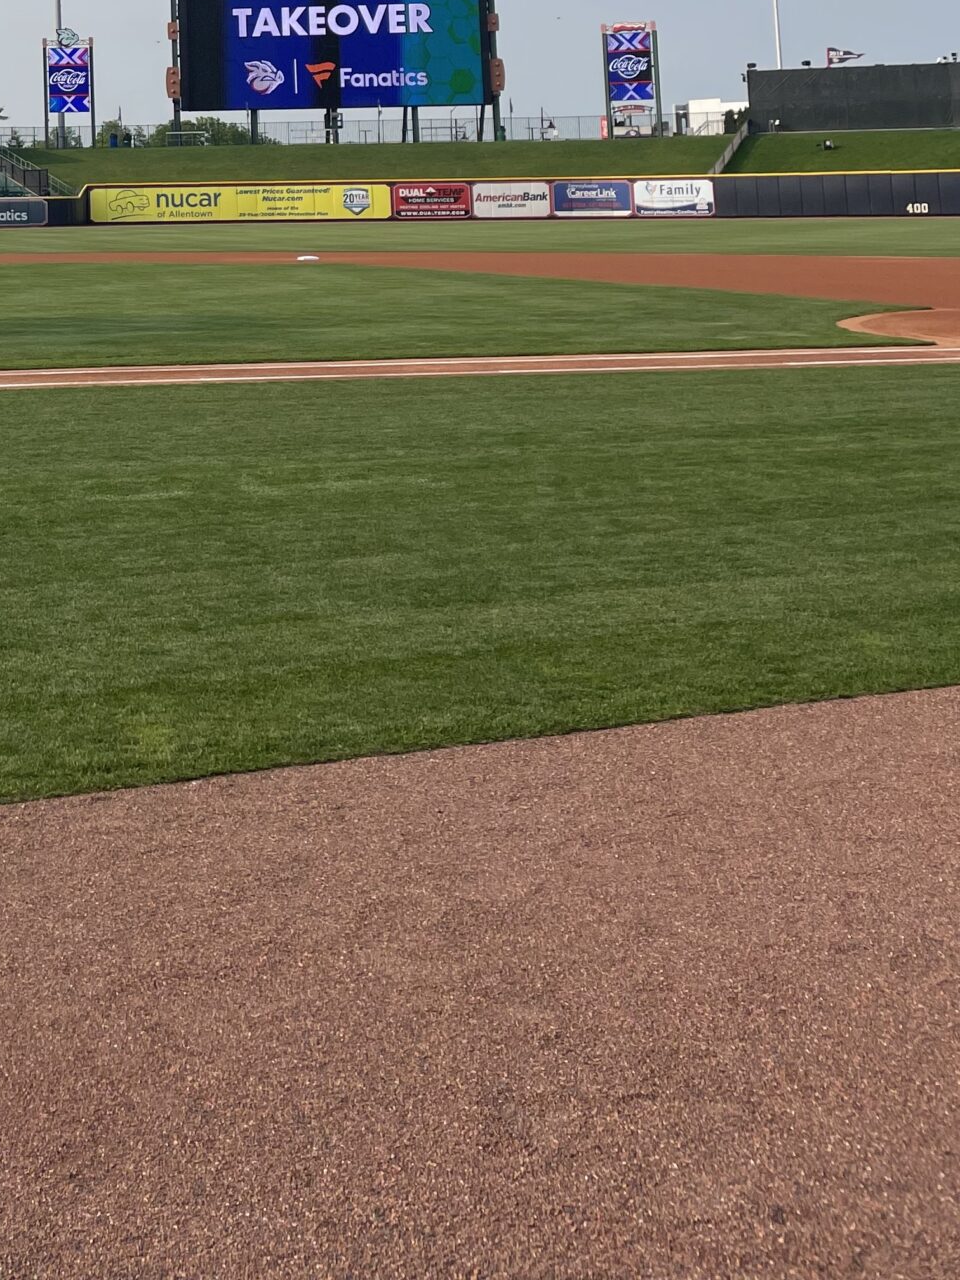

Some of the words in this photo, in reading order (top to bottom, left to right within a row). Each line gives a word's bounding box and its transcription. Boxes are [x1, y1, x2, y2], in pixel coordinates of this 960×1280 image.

[232, 3, 434, 38] TAKEOVER
[609, 57, 650, 72] Coca-Cola
[49, 71, 87, 85] Coca-Cola
[339, 67, 428, 88] Fanatics
[399, 188, 426, 197] DUAL
[436, 188, 465, 197] TEMP
[569, 188, 617, 198] CareerLink
[659, 183, 701, 197] Family
[156, 192, 222, 208] nucar
[343, 193, 355, 204] 20
[475, 192, 548, 202] AmericanBank
[168, 210, 213, 218] Allentown
[906, 203, 929, 214] 400
